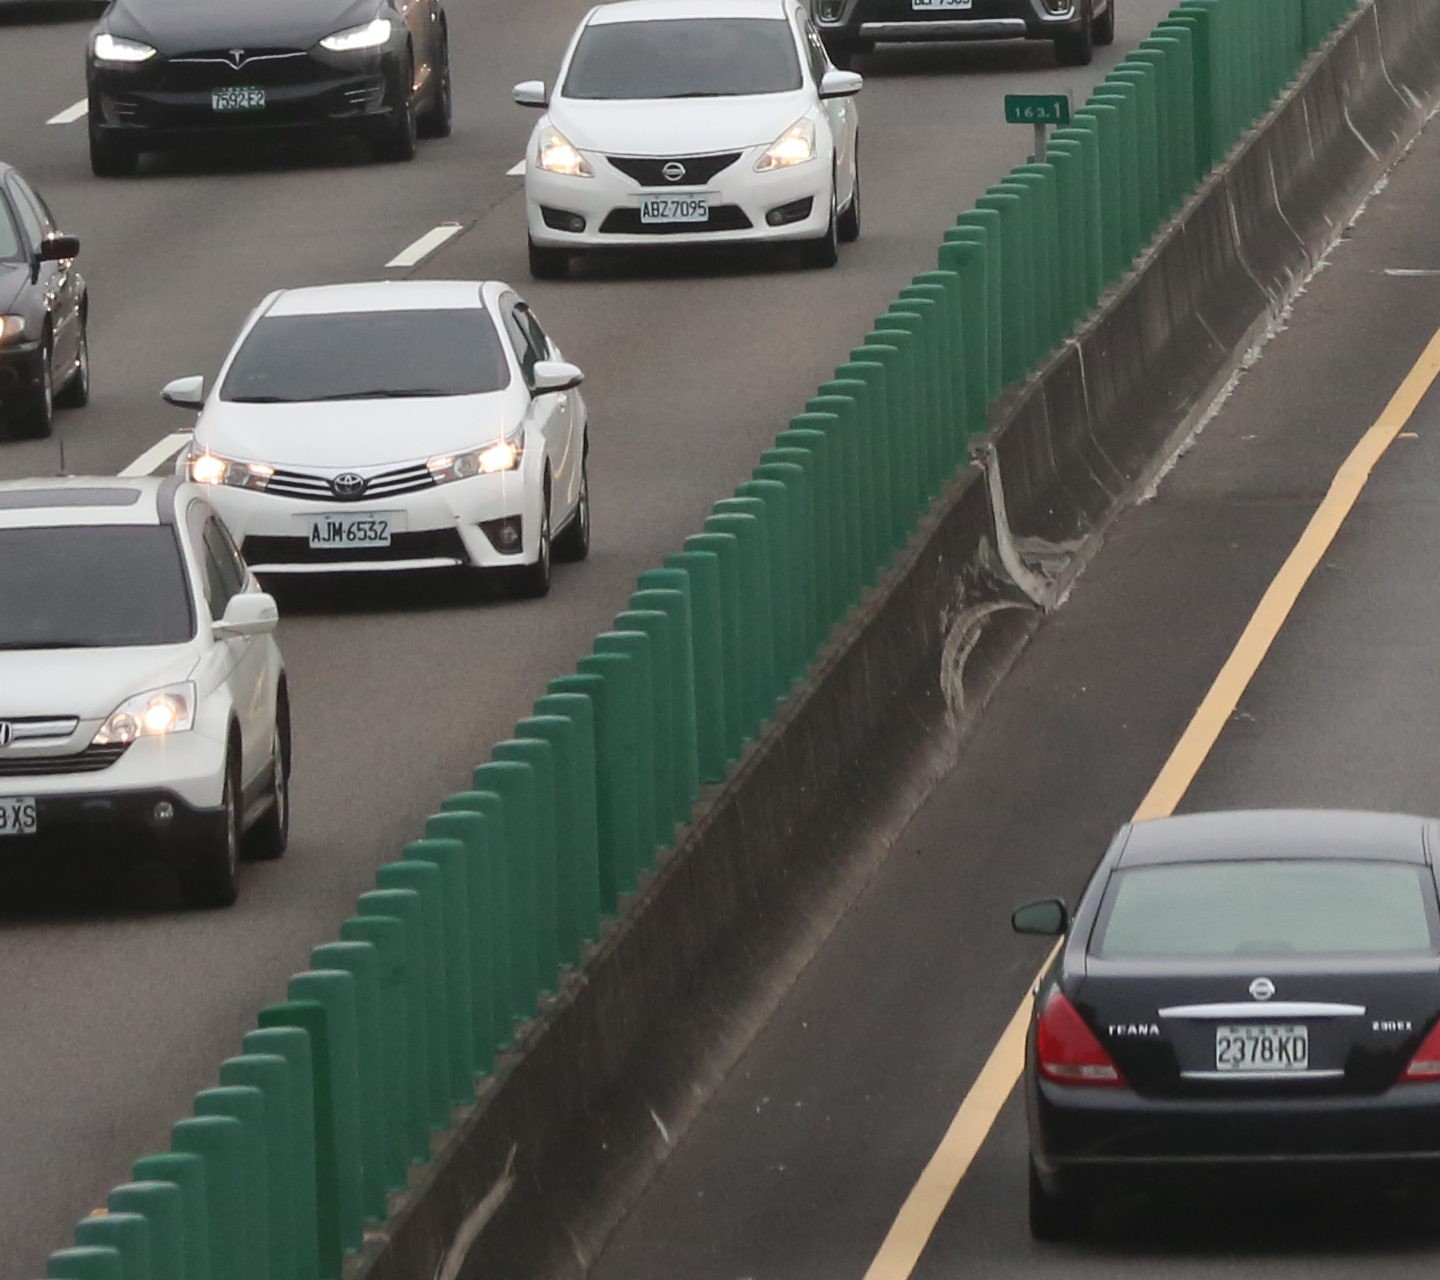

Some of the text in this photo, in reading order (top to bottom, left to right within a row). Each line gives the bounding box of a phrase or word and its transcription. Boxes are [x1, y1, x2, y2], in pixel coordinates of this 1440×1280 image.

[1015, 101, 1061, 119] 163.1
[642, 199, 708, 219] ABZ-7095
[311, 520, 389, 543] AJM-6532
[1217, 1035, 1308, 1065] 2378-KD
